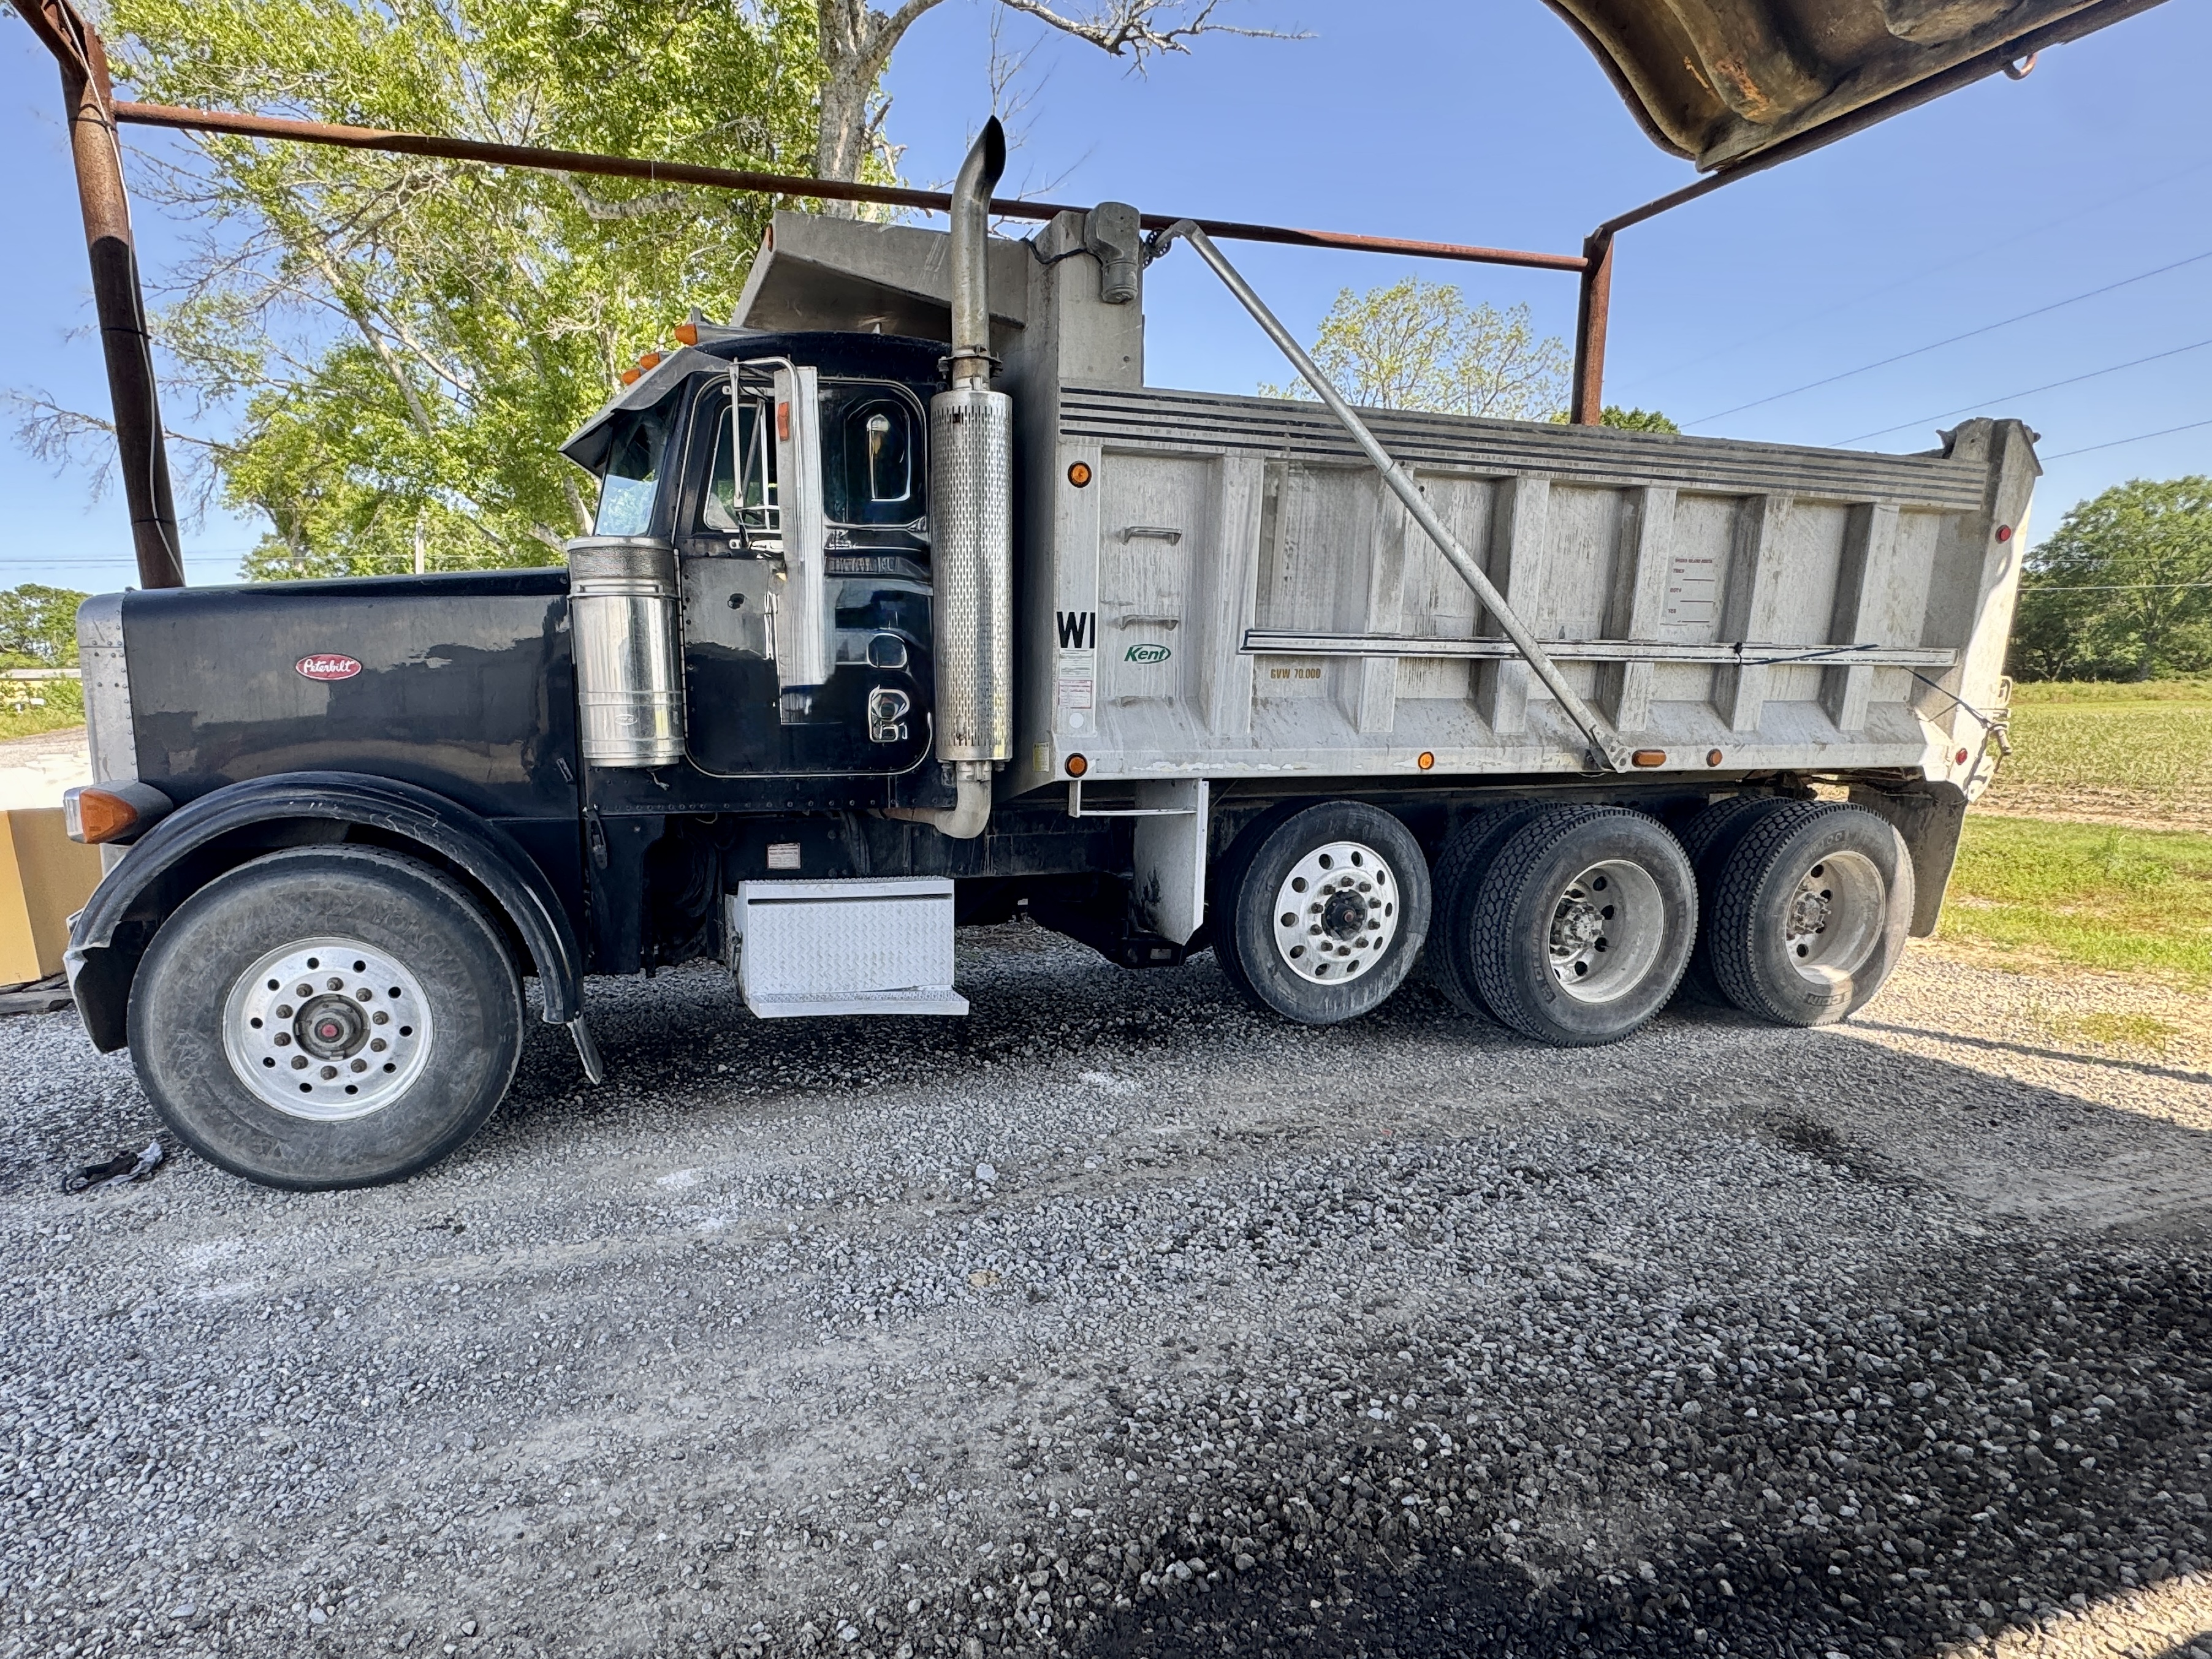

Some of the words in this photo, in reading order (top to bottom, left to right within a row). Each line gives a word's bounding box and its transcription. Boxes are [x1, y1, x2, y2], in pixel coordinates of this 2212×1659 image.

[1057, 611, 1096, 648] WI
[1123, 646, 1166, 662] Kent
[304, 658, 355, 674] Peterbilt
[1271, 669, 1290, 679] GVW
